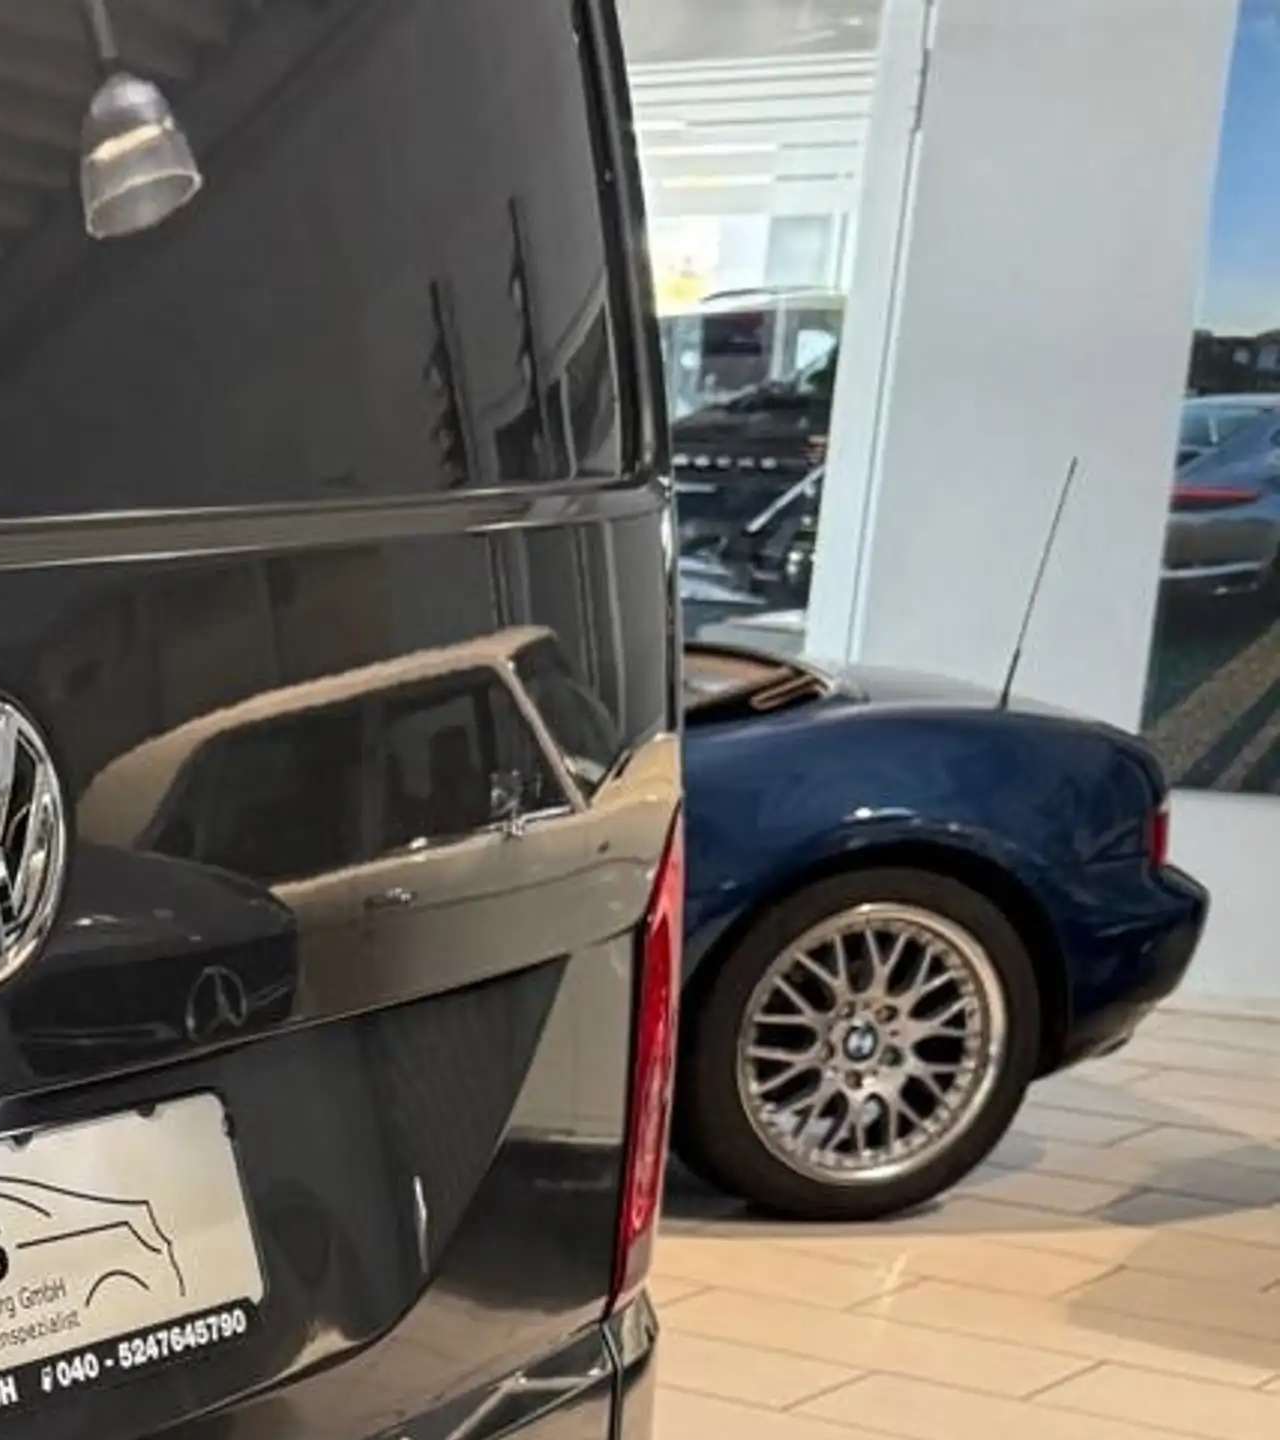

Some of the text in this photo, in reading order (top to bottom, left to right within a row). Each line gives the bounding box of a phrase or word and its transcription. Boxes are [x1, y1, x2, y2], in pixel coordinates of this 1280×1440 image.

[19, 1276, 67, 1310] GmbH
[55, 1351, 101, 1388] 040
[117, 1307, 248, 1370] 5247645790
